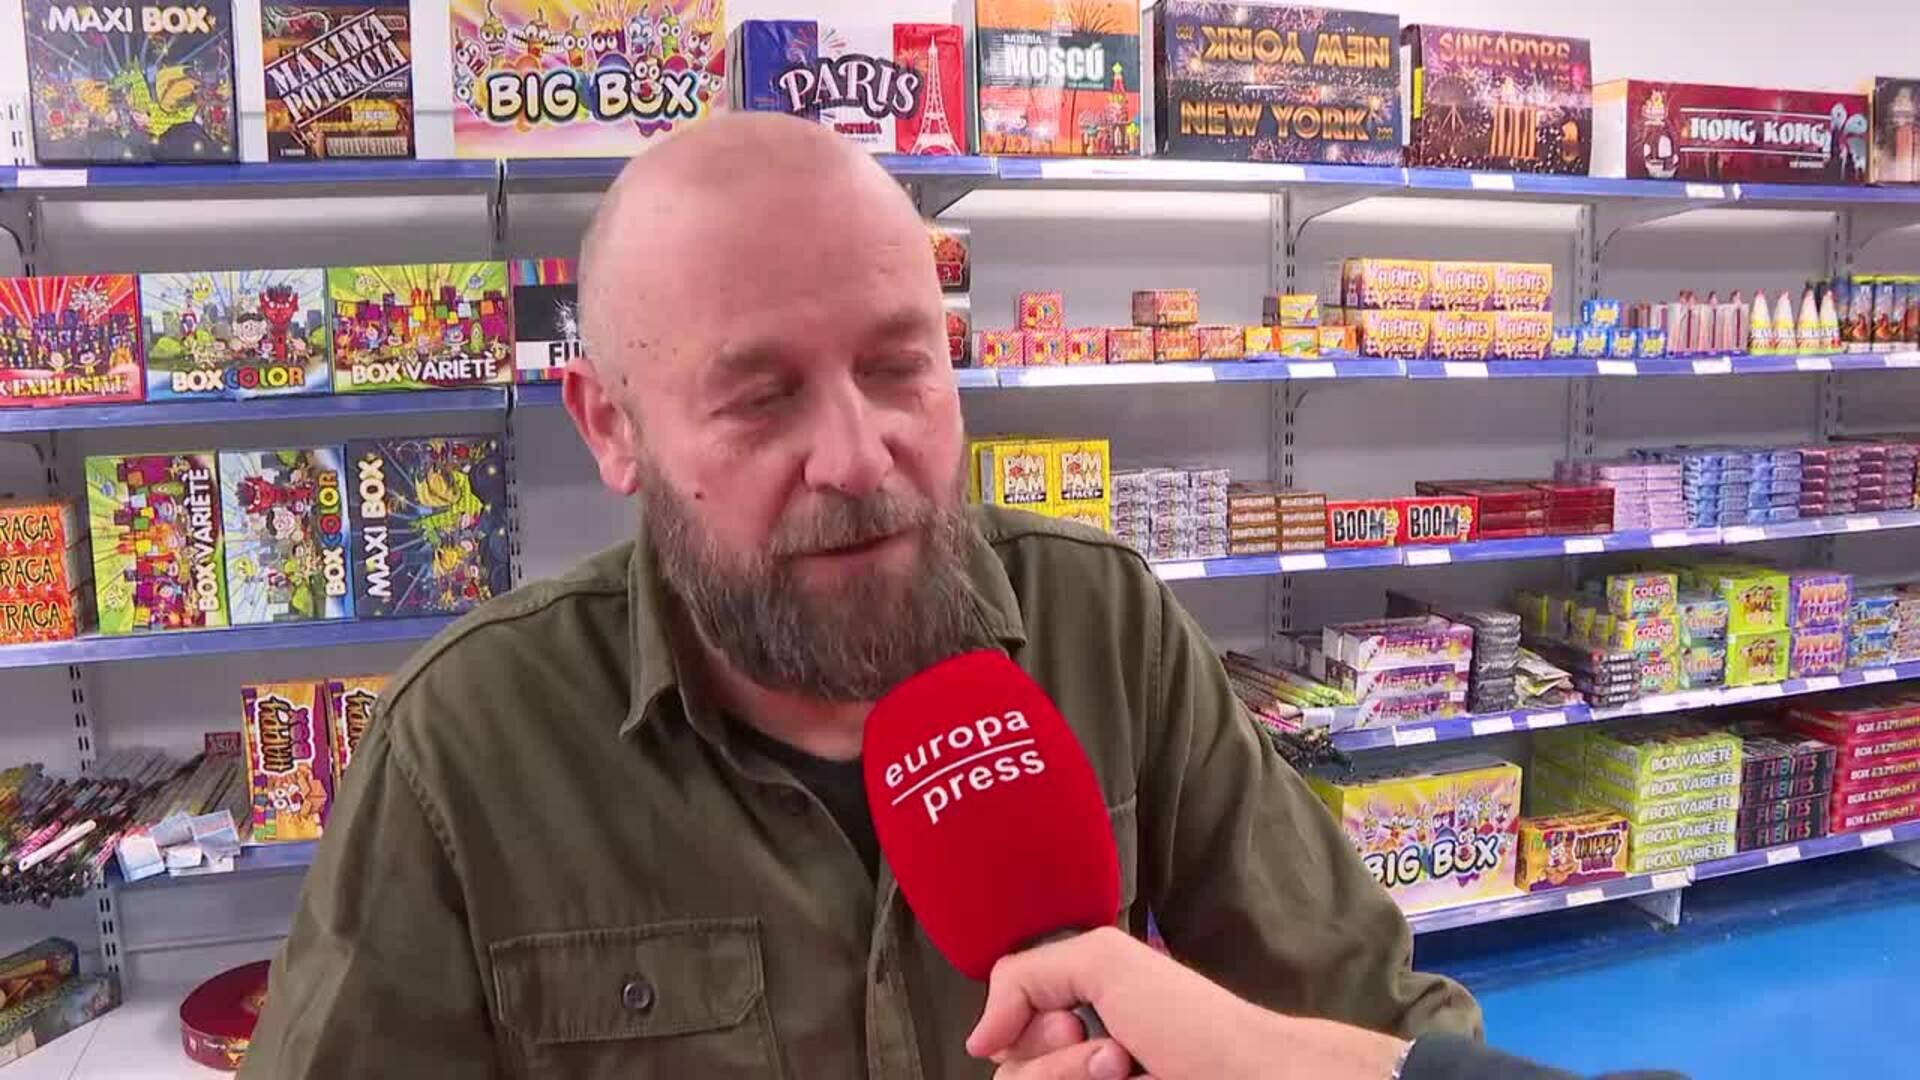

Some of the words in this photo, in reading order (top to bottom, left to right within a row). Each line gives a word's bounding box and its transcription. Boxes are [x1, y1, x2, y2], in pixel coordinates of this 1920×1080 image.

[47, 8, 133, 33] MAXI
[141, 7, 210, 33] BOX
[267, 14, 392, 96] MAXIMA
[1005, 43, 1104, 82] MOSCÚ
[1201, 24, 1305, 66] YORK
[1313, 33, 1392, 69] NEW
[283, 40, 408, 122] POTENCIA
[488, 71, 579, 122] BIG
[596, 71, 699, 121] BOX
[779, 57, 920, 115] PARIS
[1180, 101, 1263, 136] NEW
[1271, 105, 1369, 141] YORK
[1689, 117, 1756, 144] HONG
[1763, 121, 1828, 148] KONG
[172, 368, 225, 393] BOX
[224, 366, 305, 390] COLOR
[352, 364, 401, 384] BOX
[319, 471, 342, 546] COLOR
[358, 458, 386, 519] BOX
[1333, 509, 1386, 542] BOOM
[1408, 504, 1460, 538] BOOM
[324, 547, 346, 596] BOX
[363, 526, 392, 598] MAXI
[194, 562, 219, 611] BOX
[1641, 663, 1673, 677] OLOR
[885, 709, 1031, 788] europa
[922, 749, 1046, 825] press
[1432, 837, 1499, 879] BOX
